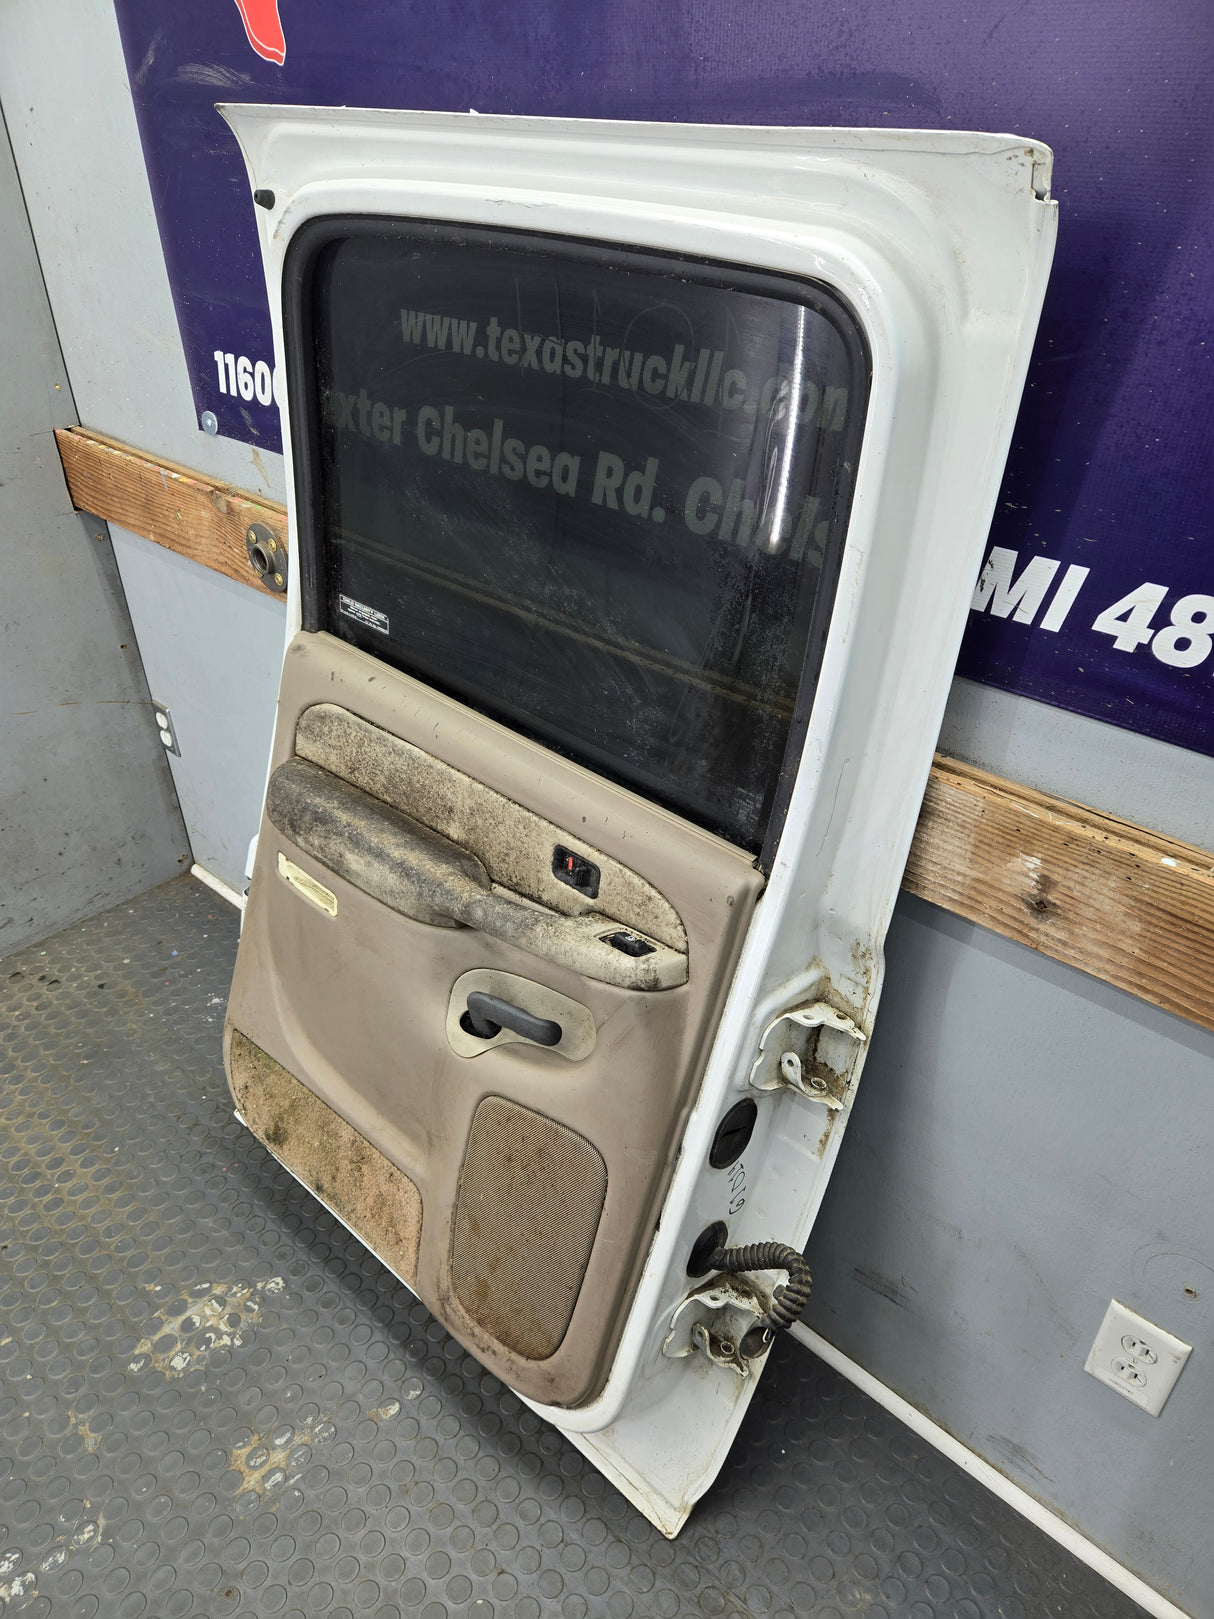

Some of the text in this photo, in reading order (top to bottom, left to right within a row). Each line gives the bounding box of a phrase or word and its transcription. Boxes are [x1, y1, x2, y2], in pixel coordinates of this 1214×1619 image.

[334, 388, 407, 447] xter
[417, 405, 581, 497] Chelsea
[591, 451, 665, 523] Rd.
[970, 546, 1091, 633] MI
[1091, 582, 1214, 677] 48
